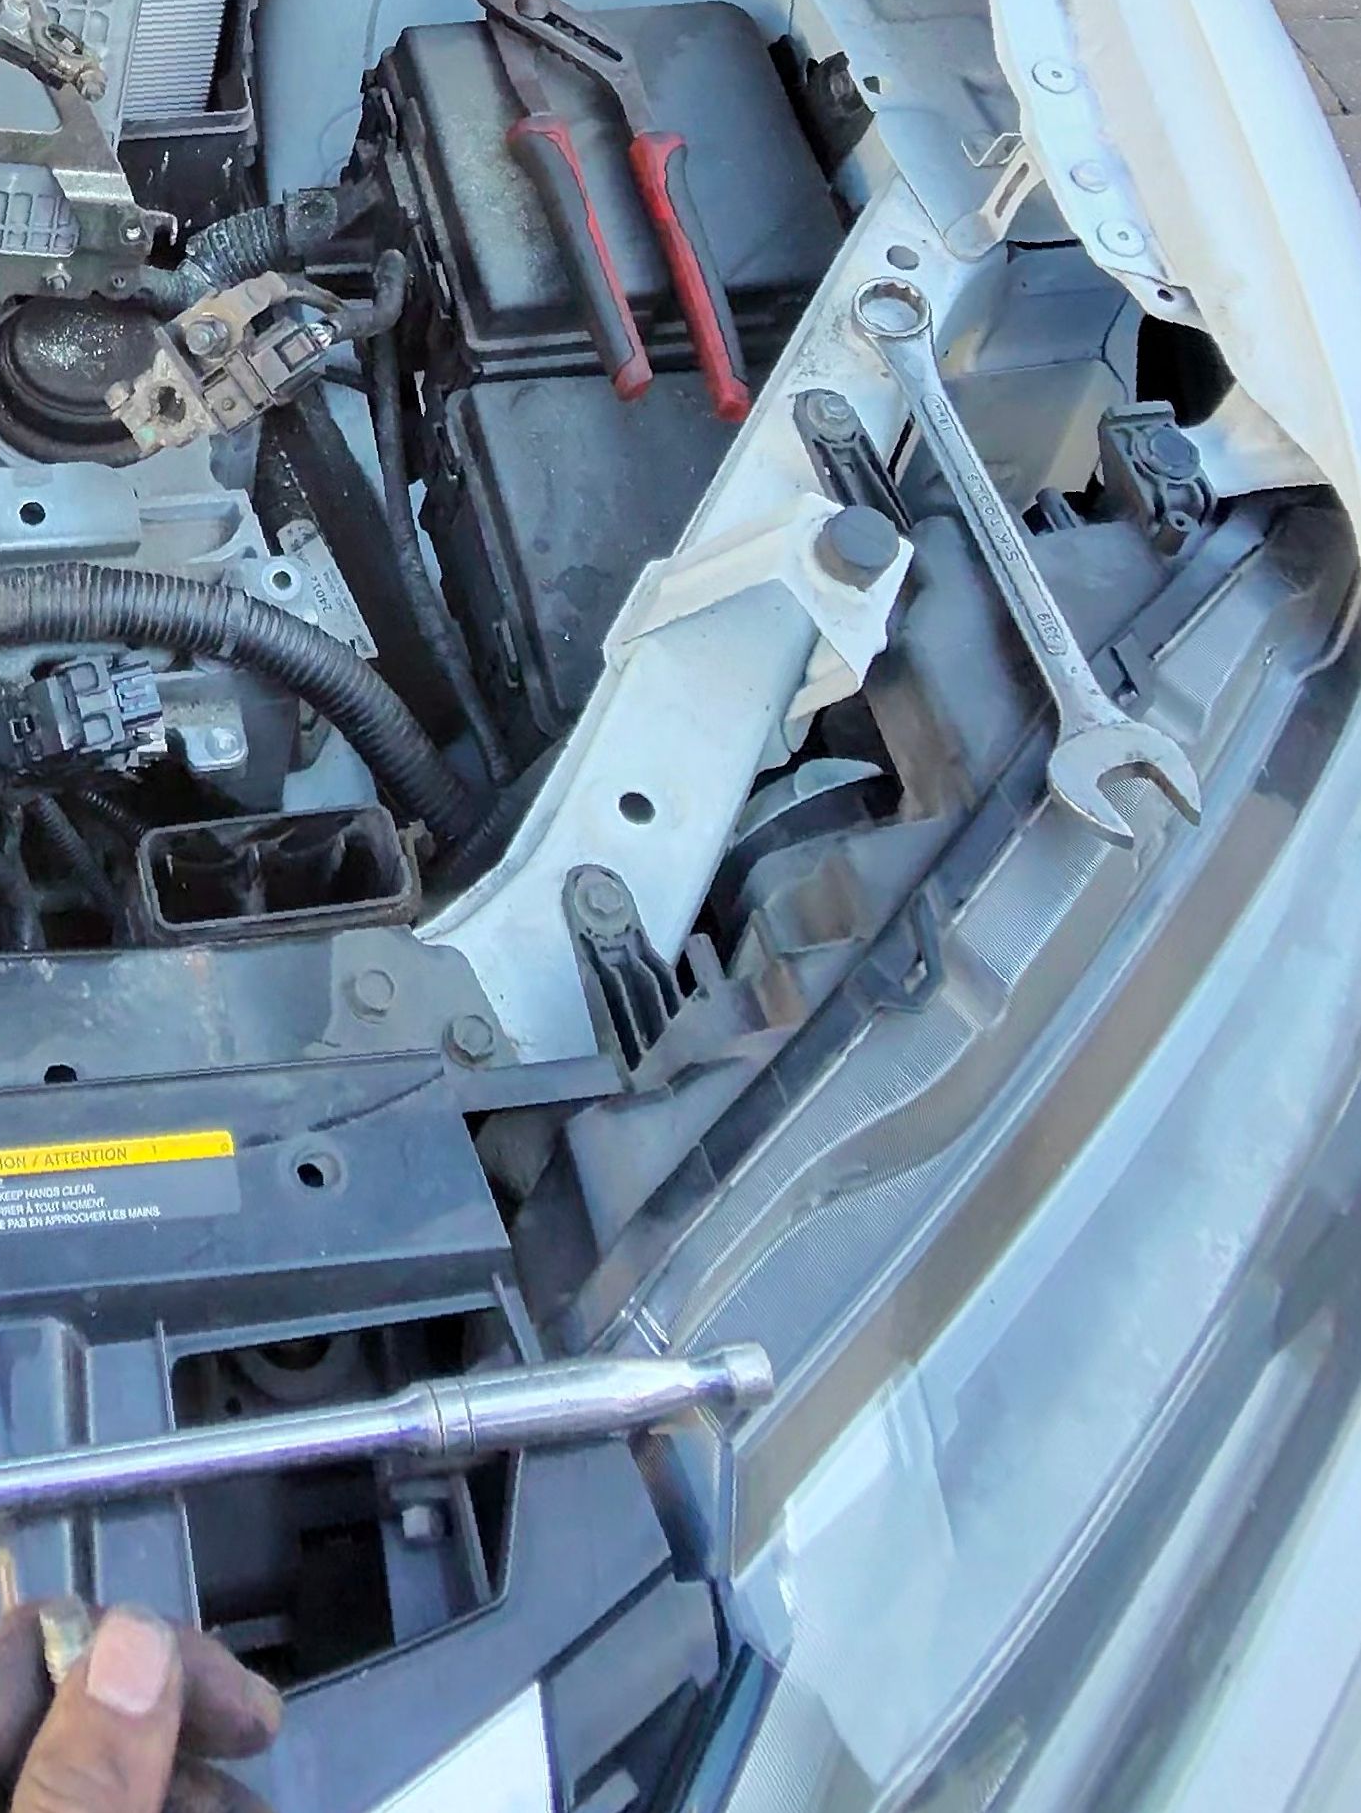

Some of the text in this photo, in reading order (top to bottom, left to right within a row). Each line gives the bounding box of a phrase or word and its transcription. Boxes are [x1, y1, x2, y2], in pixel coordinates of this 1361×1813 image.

[44, 1147, 128, 1167] ATTENTION
[25, 1186, 60, 1199] HANDS
[26, 1201, 33, 1215] À
[34, 1201, 60, 1213] TOUT
[7, 1217, 27, 1229] PAS
[28, 1216, 43, 1228] EN
[45, 1210, 106, 1226] APPROCHER
[107, 1208, 127, 1220] LES
